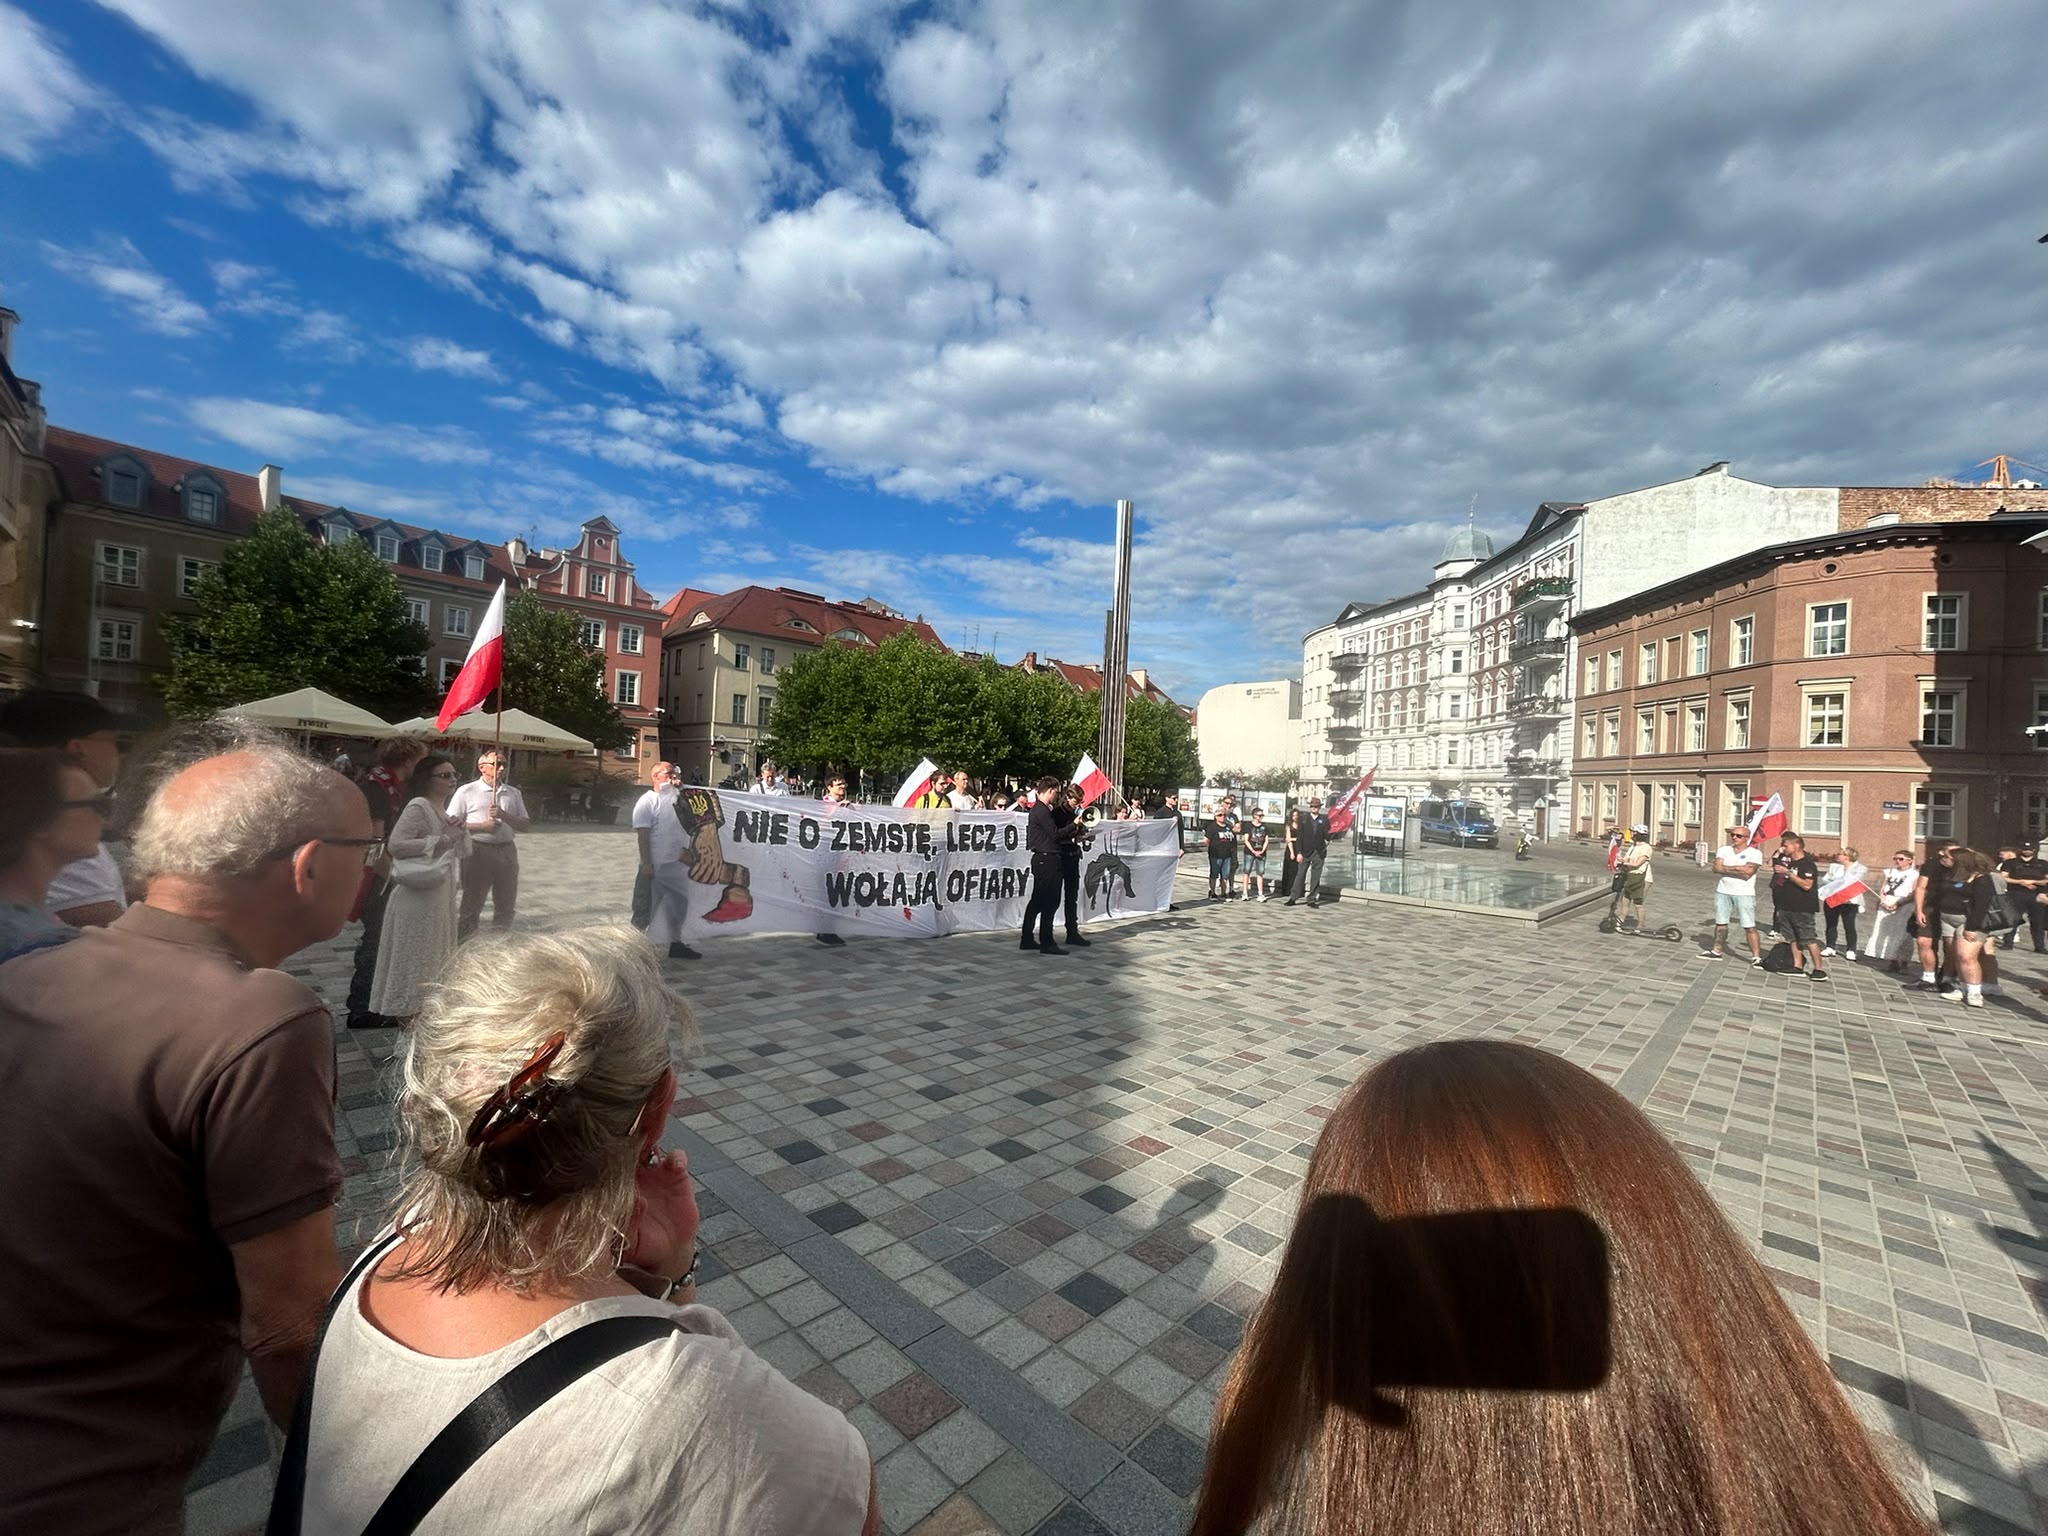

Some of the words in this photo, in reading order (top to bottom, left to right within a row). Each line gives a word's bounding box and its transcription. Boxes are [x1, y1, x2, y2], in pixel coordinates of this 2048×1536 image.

[733, 810, 789, 845] NIE
[799, 818, 820, 849] O
[831, 820, 938, 861] ZEMSTĘ,
[947, 822, 997, 852] LECZ
[1004, 825, 1018, 851] O
[826, 871, 943, 911] WOŁAJĄ
[947, 867, 1030, 902] OFIARY
